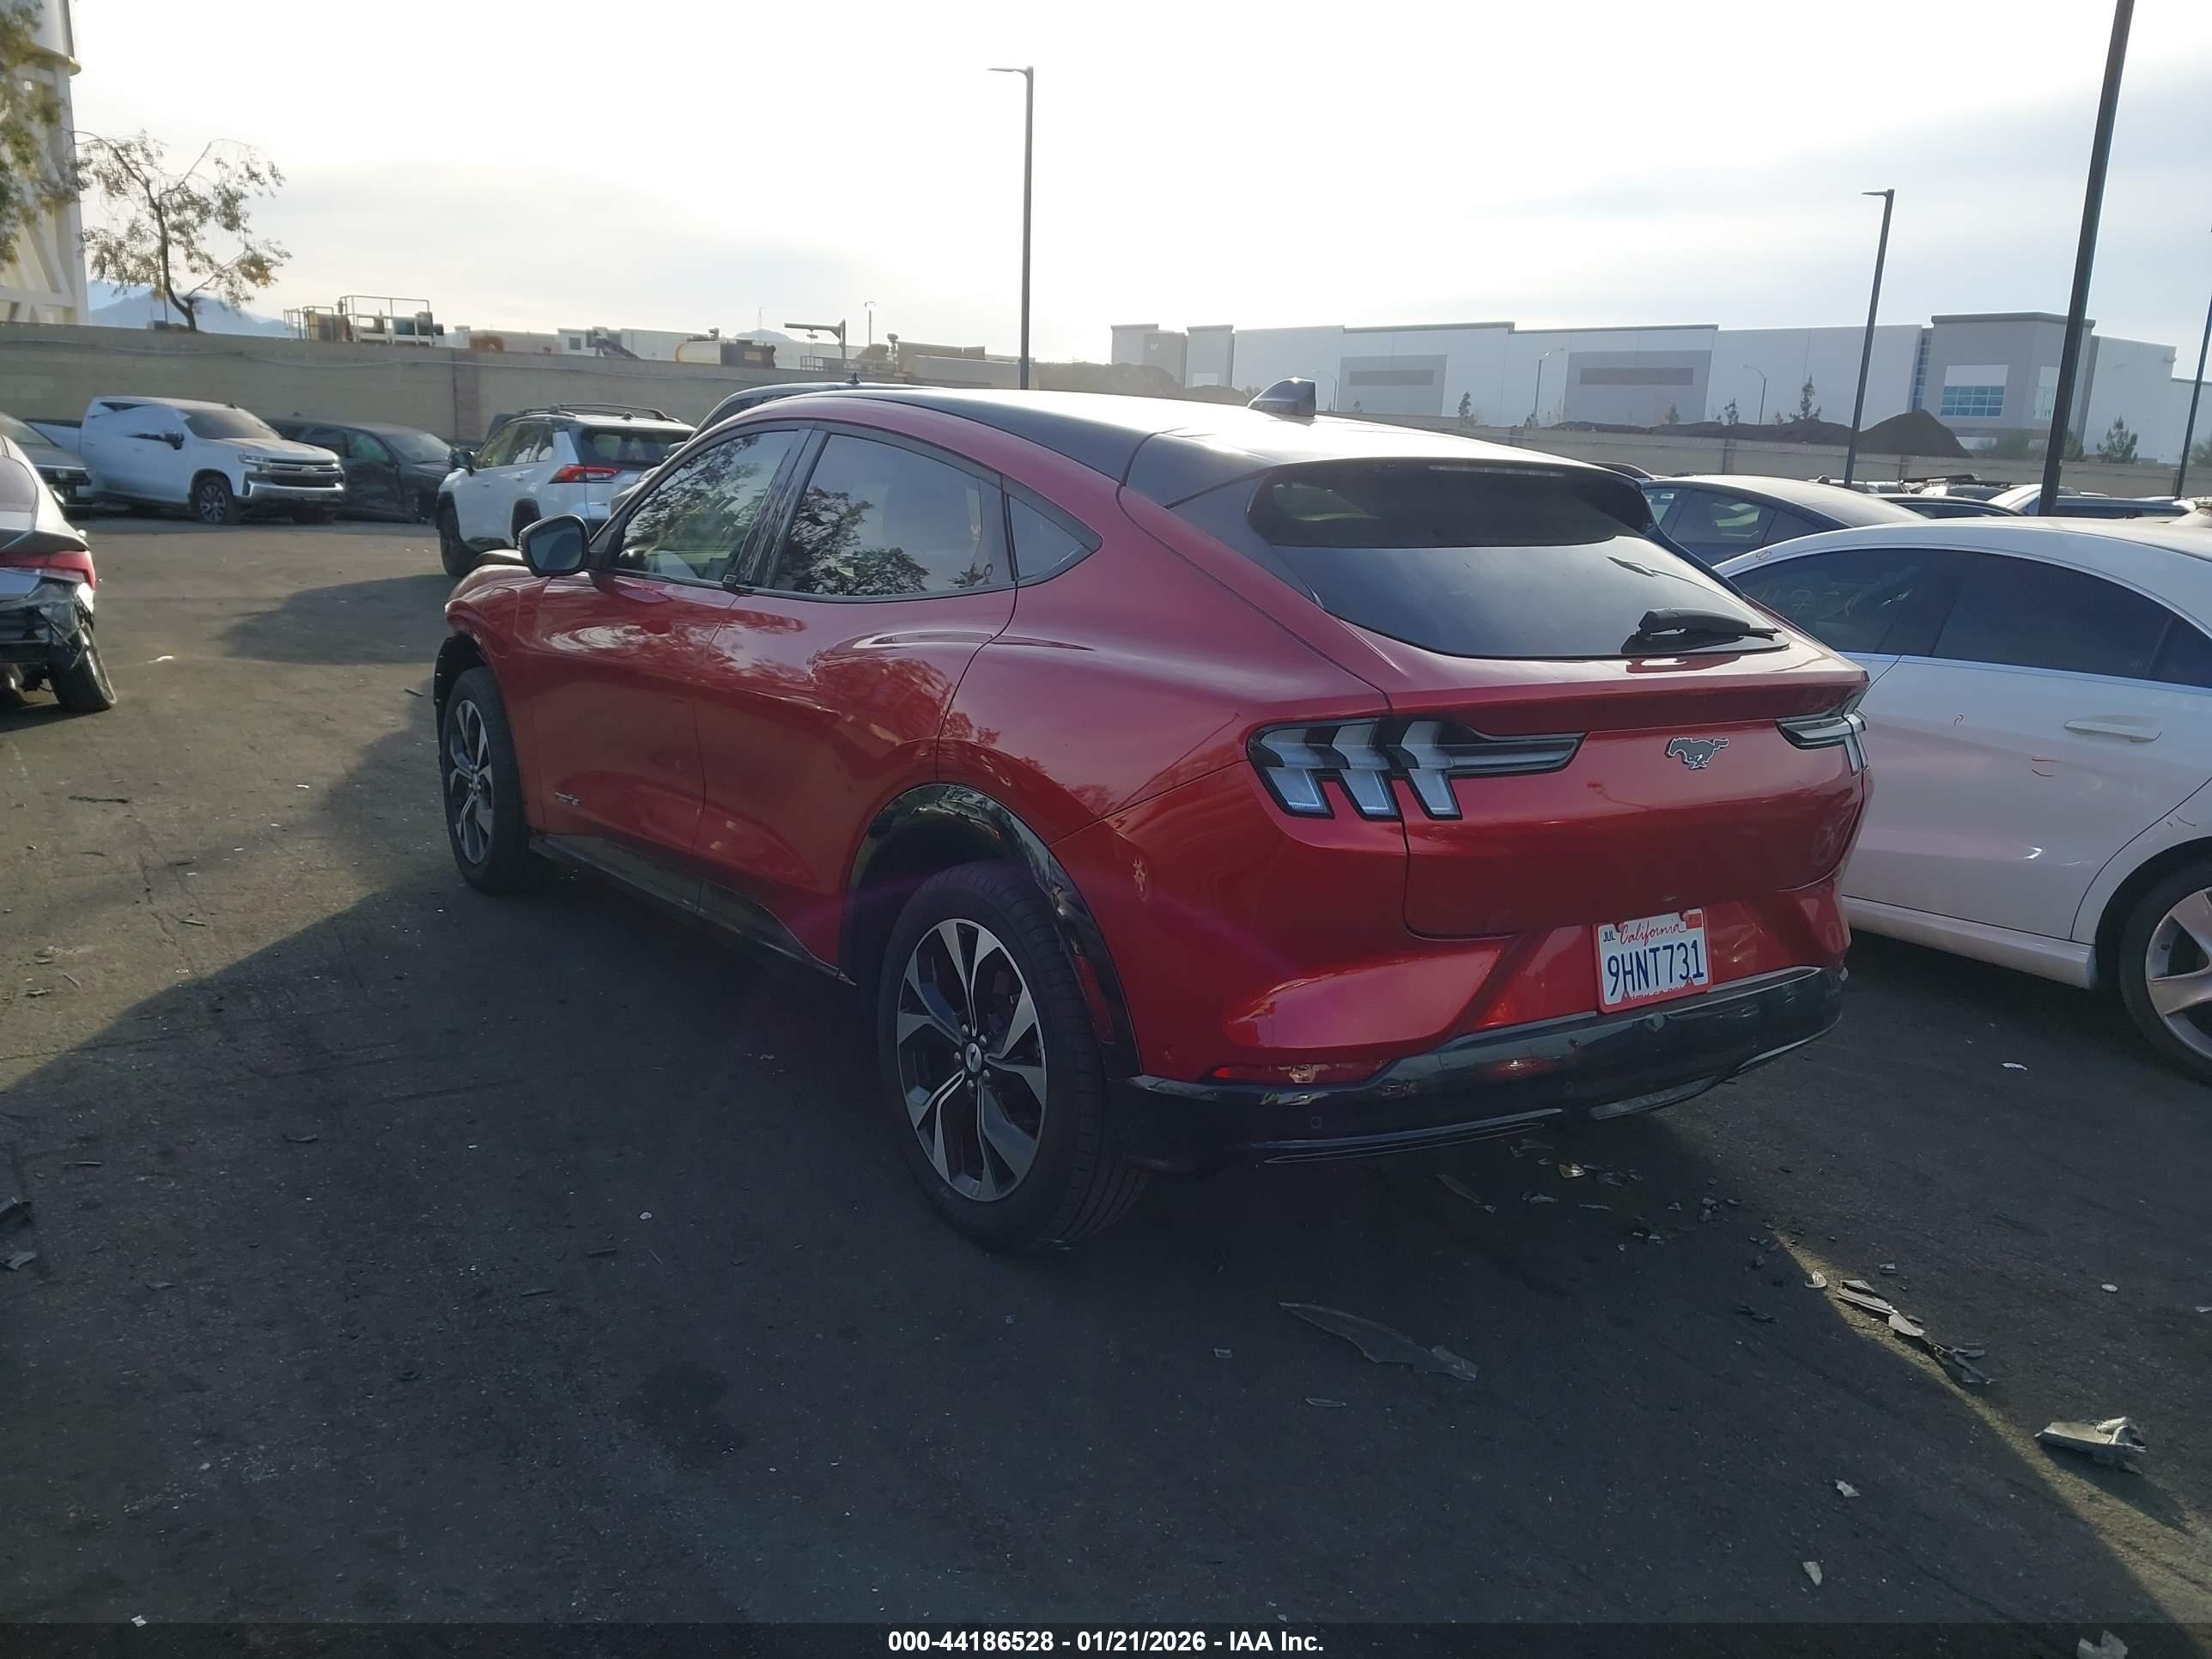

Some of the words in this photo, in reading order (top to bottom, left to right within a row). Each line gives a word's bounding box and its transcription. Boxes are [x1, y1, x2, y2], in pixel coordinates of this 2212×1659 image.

[1602, 931, 1616, 942] JUL
[1620, 921, 1686, 946] California
[1607, 939, 1705, 997] 9HNT731
